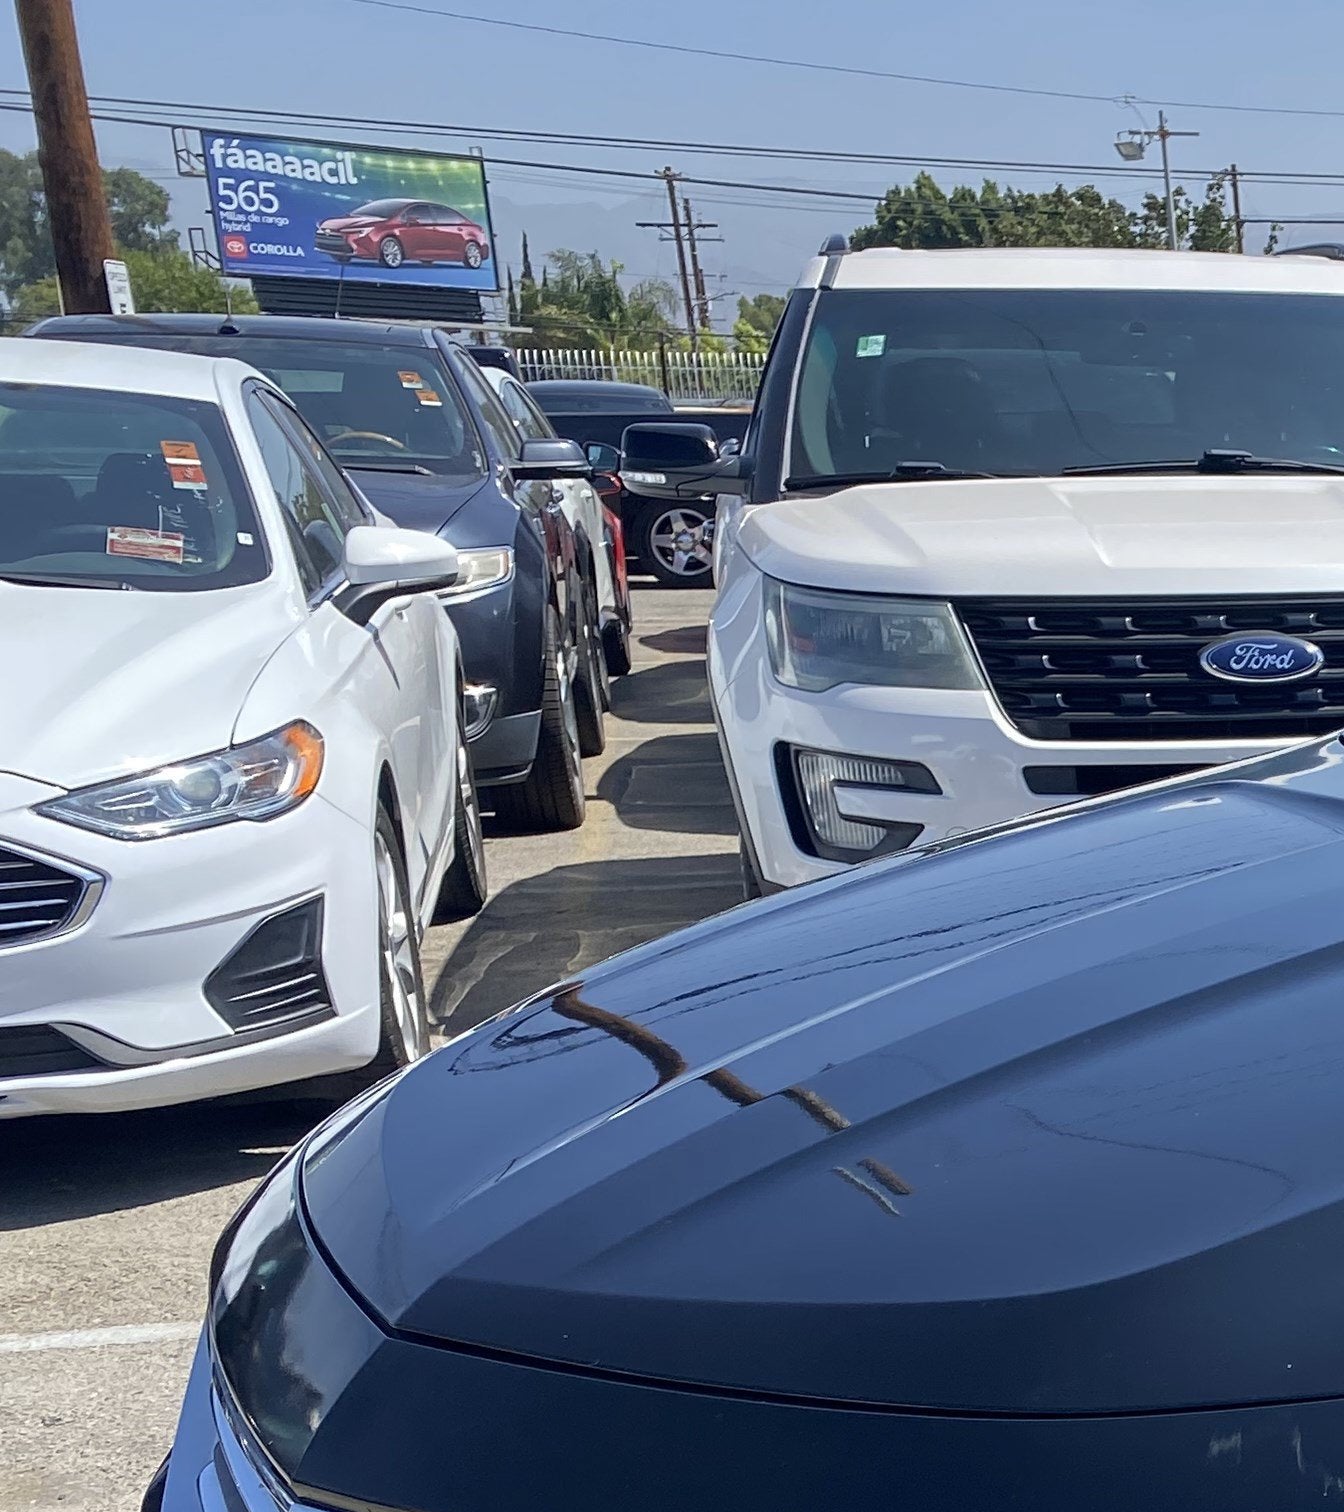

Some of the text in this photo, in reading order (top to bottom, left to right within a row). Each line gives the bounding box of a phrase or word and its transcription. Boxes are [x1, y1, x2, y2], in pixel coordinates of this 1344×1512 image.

[217, 177, 280, 214] 565
[247, 213, 261, 223] de
[249, 242, 305, 258] COROLLA
[1229, 643, 1295, 671] Ford
